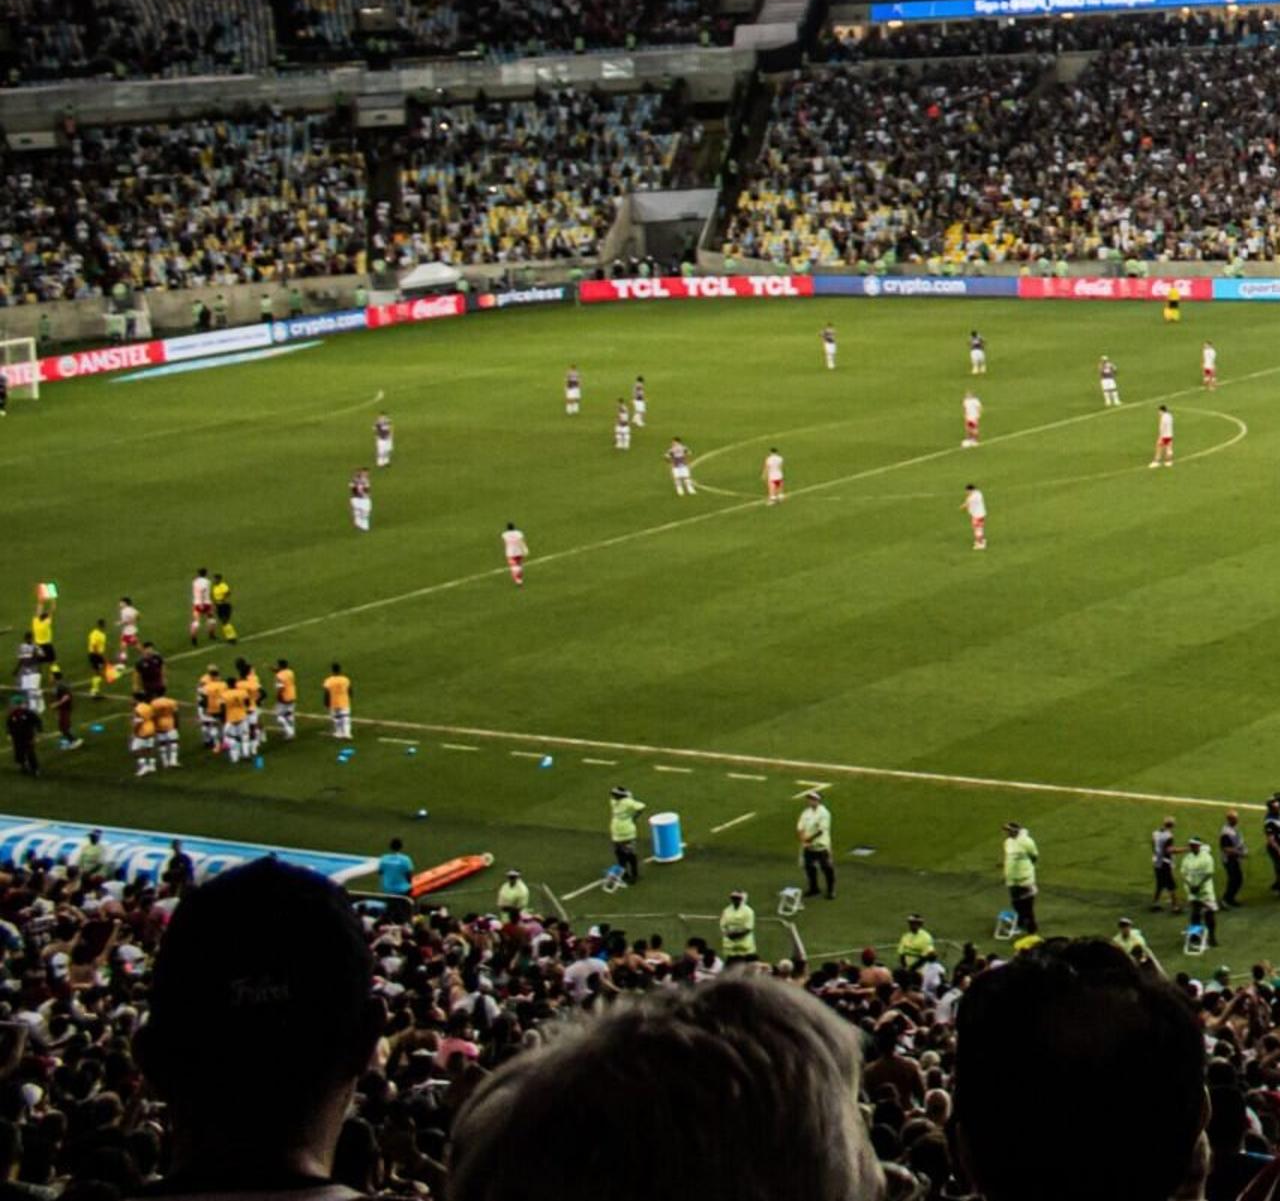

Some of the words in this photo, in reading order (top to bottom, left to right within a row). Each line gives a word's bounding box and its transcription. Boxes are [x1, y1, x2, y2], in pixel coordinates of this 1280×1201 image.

[611, 277, 670, 299] TCL
[683, 276, 736, 297] TCL
[749, 275, 798, 296] TCL
[883, 278, 967, 295] crypto.com
[290, 310, 367, 337] crypto.com
[80, 344, 151, 374] AMSTEL
